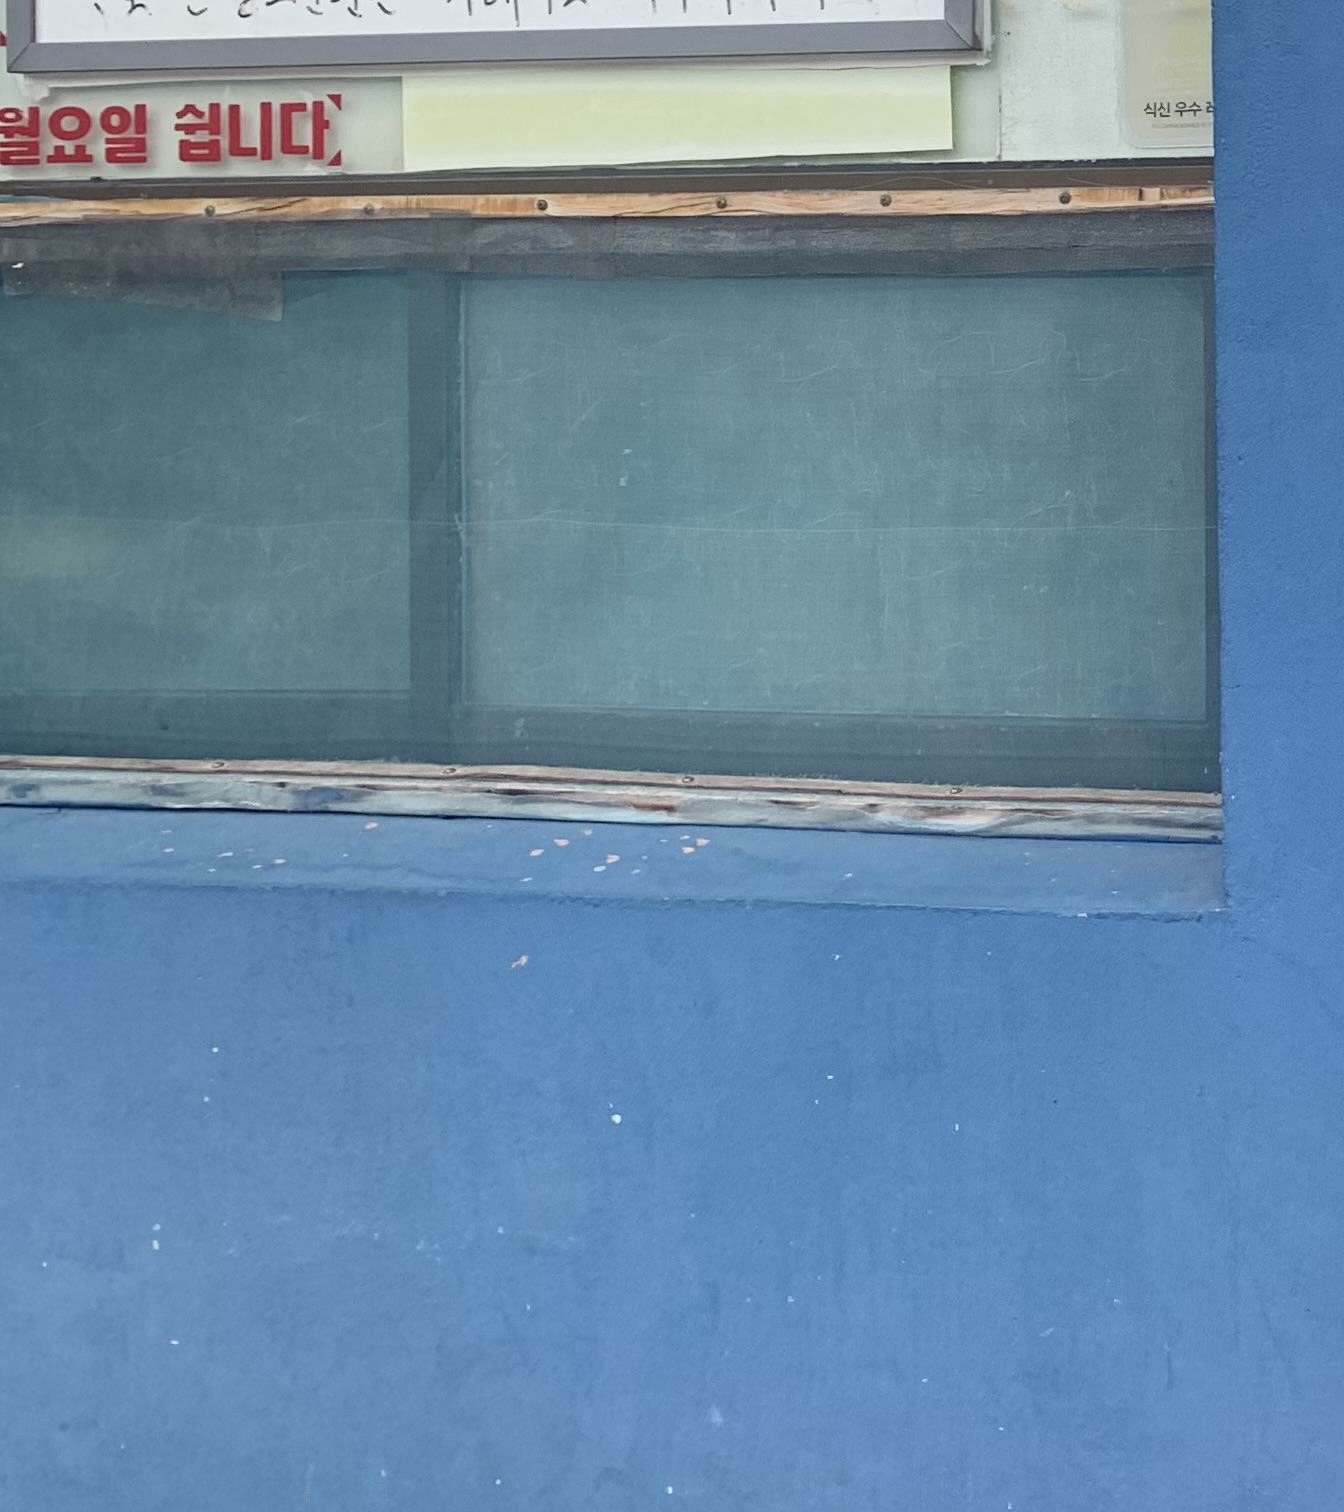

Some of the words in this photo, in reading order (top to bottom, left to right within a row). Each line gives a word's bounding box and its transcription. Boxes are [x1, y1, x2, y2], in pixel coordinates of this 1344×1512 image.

[1144, 102, 1171, 118] 식신
[1175, 101, 1202, 117] 우수
[0, 104, 149, 166] 월요일
[174, 100, 330, 164] 쉽니다
